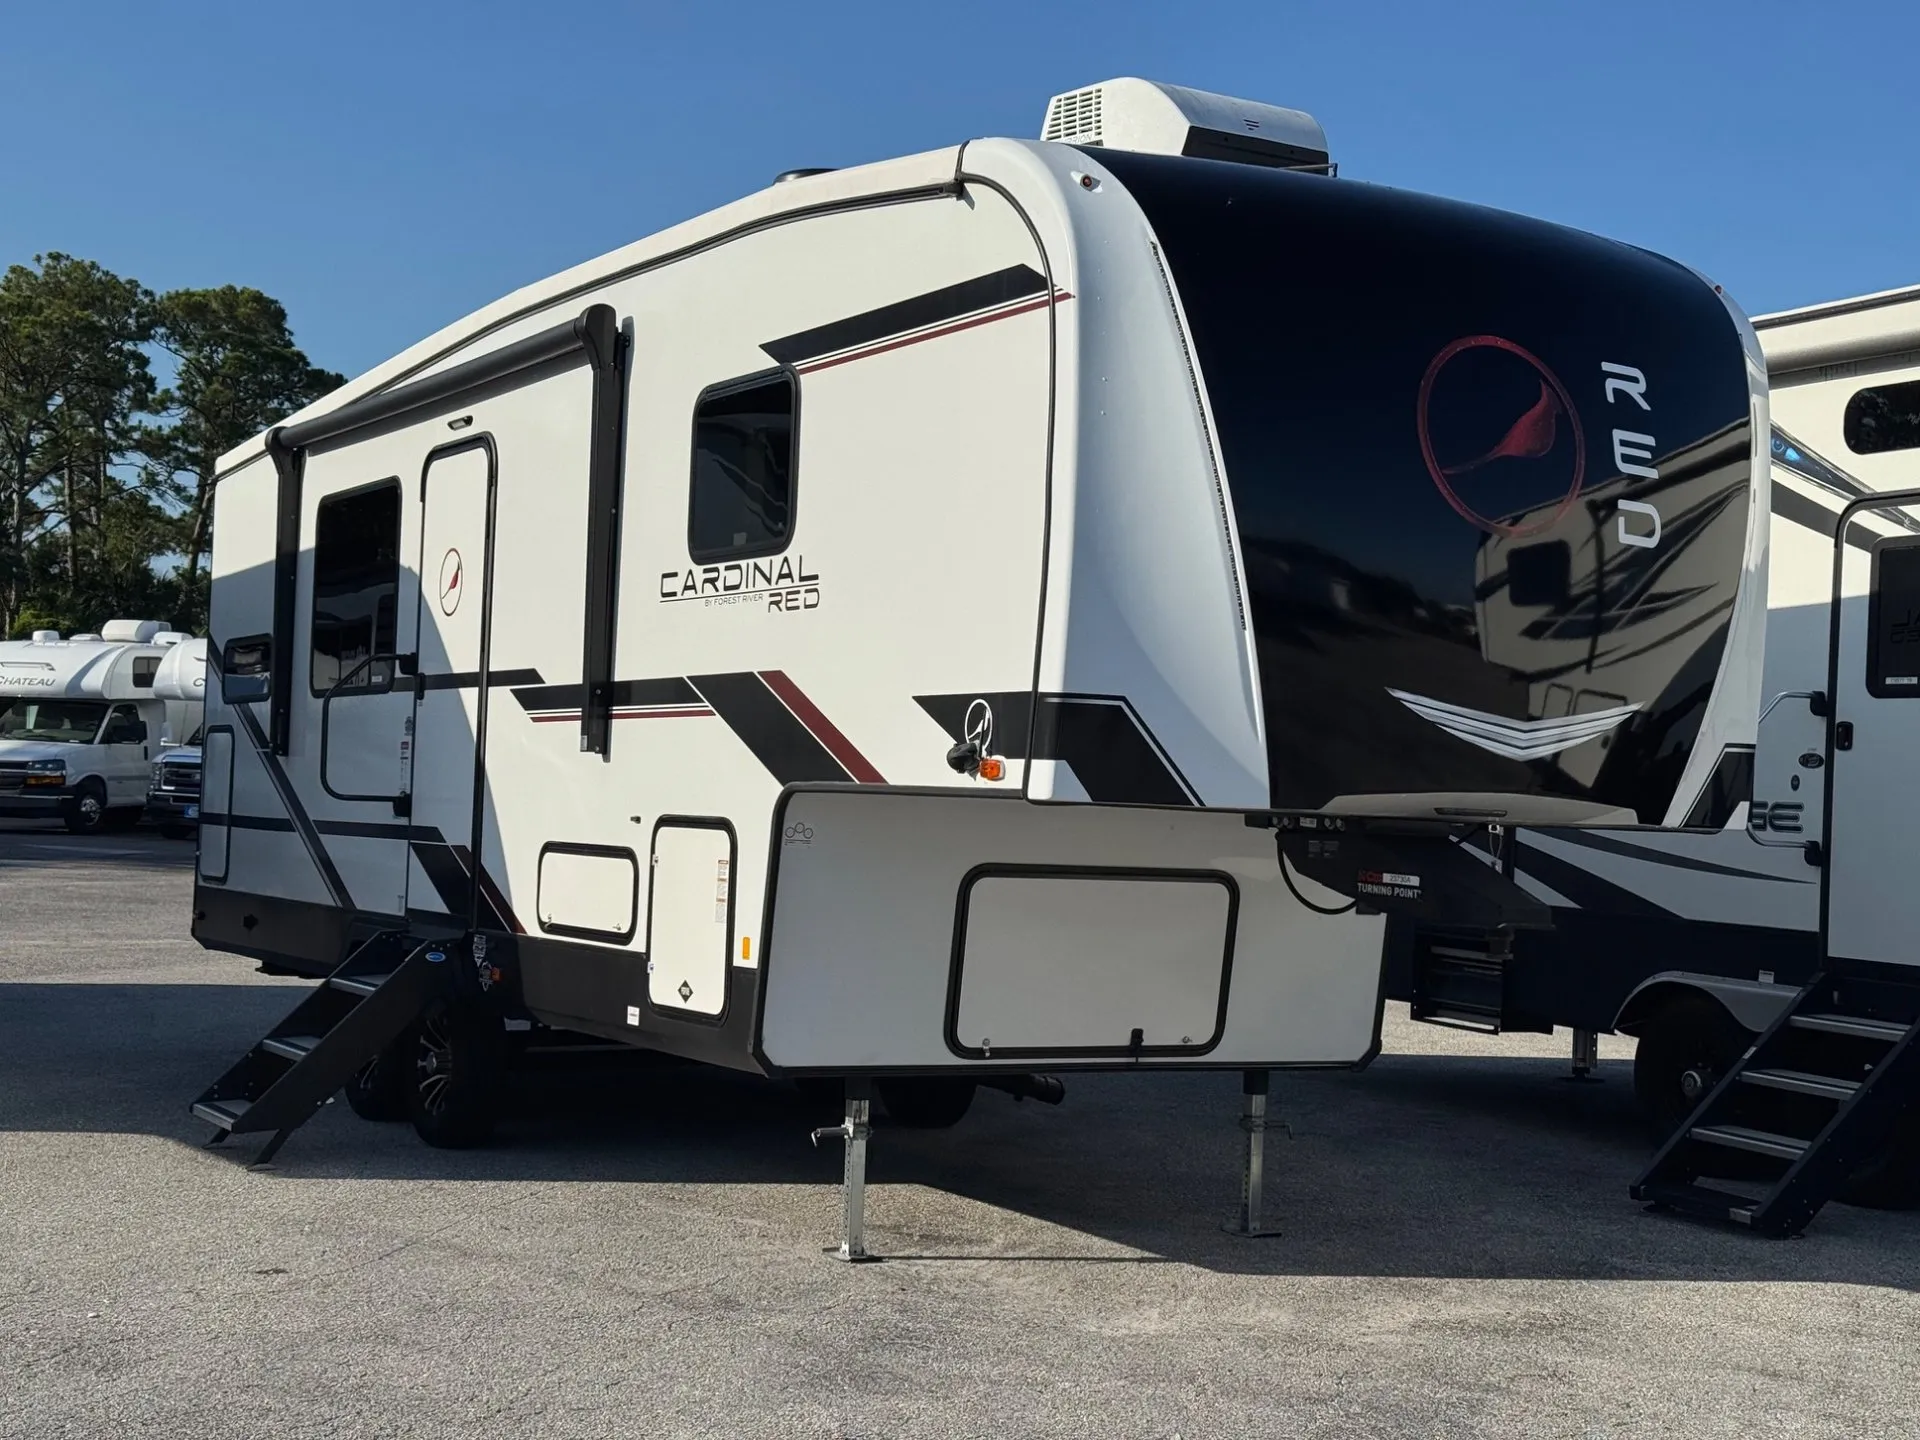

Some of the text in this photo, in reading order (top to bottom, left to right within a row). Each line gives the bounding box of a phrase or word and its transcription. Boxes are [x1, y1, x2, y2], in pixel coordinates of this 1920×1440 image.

[1601, 362, 1662, 549] RED
[660, 555, 820, 598] CARDINAL
[704, 593, 764, 607] BY FOREST RIVER
[768, 587, 820, 613] RED
[1357, 883, 1393, 896] TURNING
